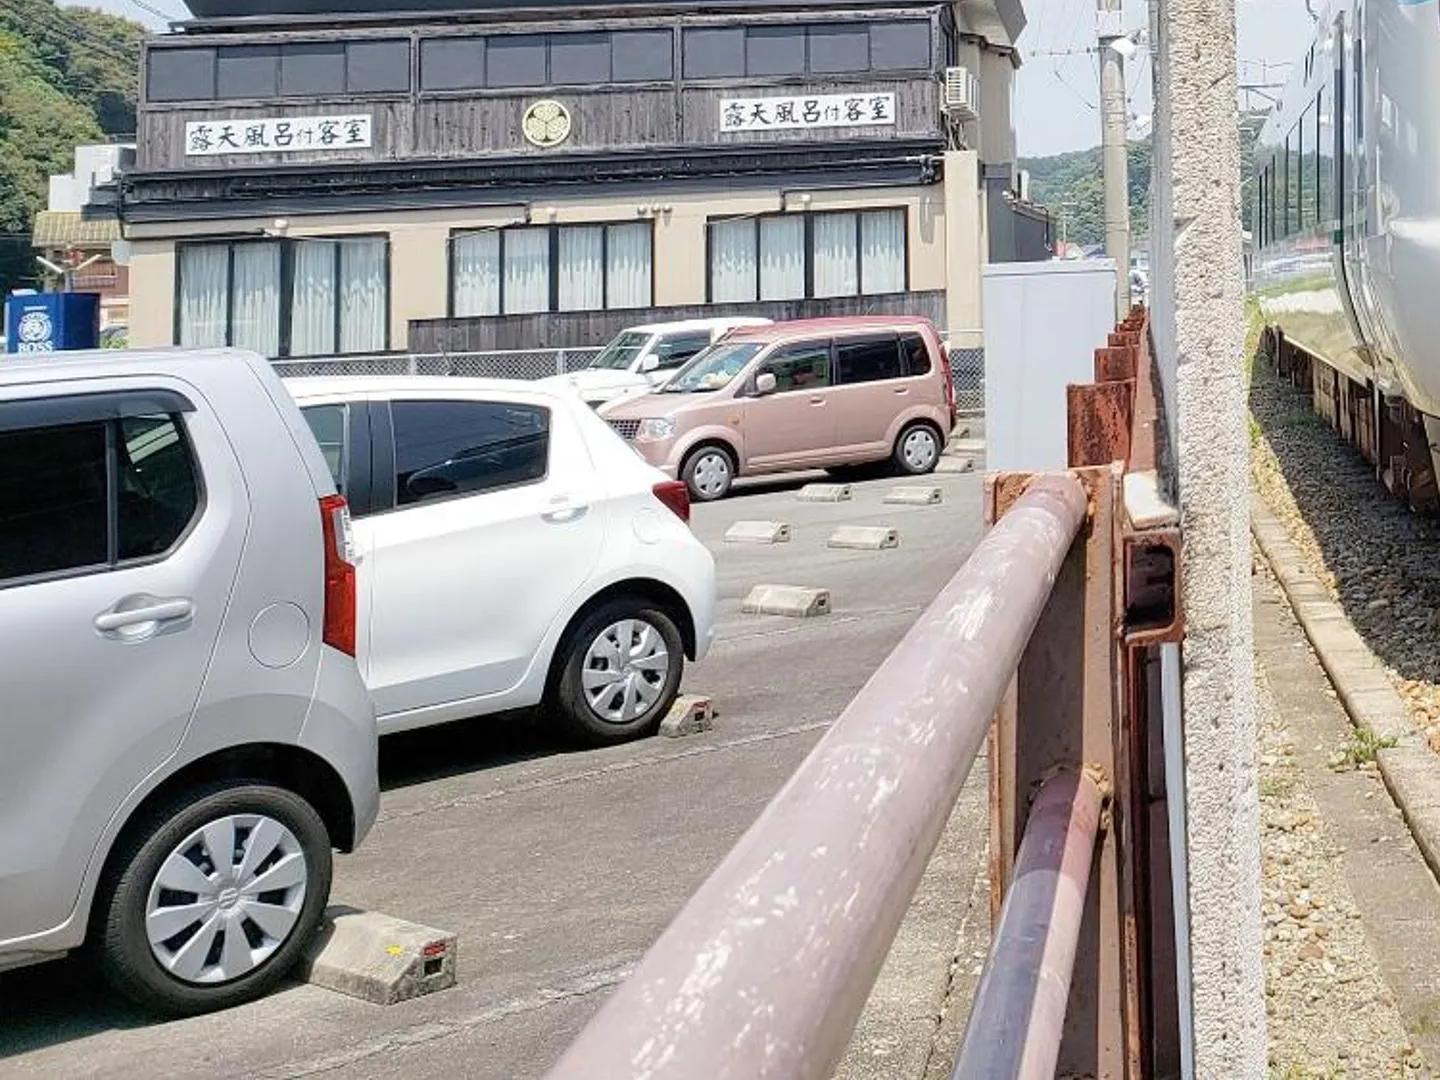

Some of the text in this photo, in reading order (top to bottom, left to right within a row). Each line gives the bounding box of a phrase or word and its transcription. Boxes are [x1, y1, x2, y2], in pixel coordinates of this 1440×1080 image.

[723, 96, 891, 128] 露天風呂付客室
[188, 118, 367, 152] 露天風呂付客室
[18, 340, 53, 353] BOSS
